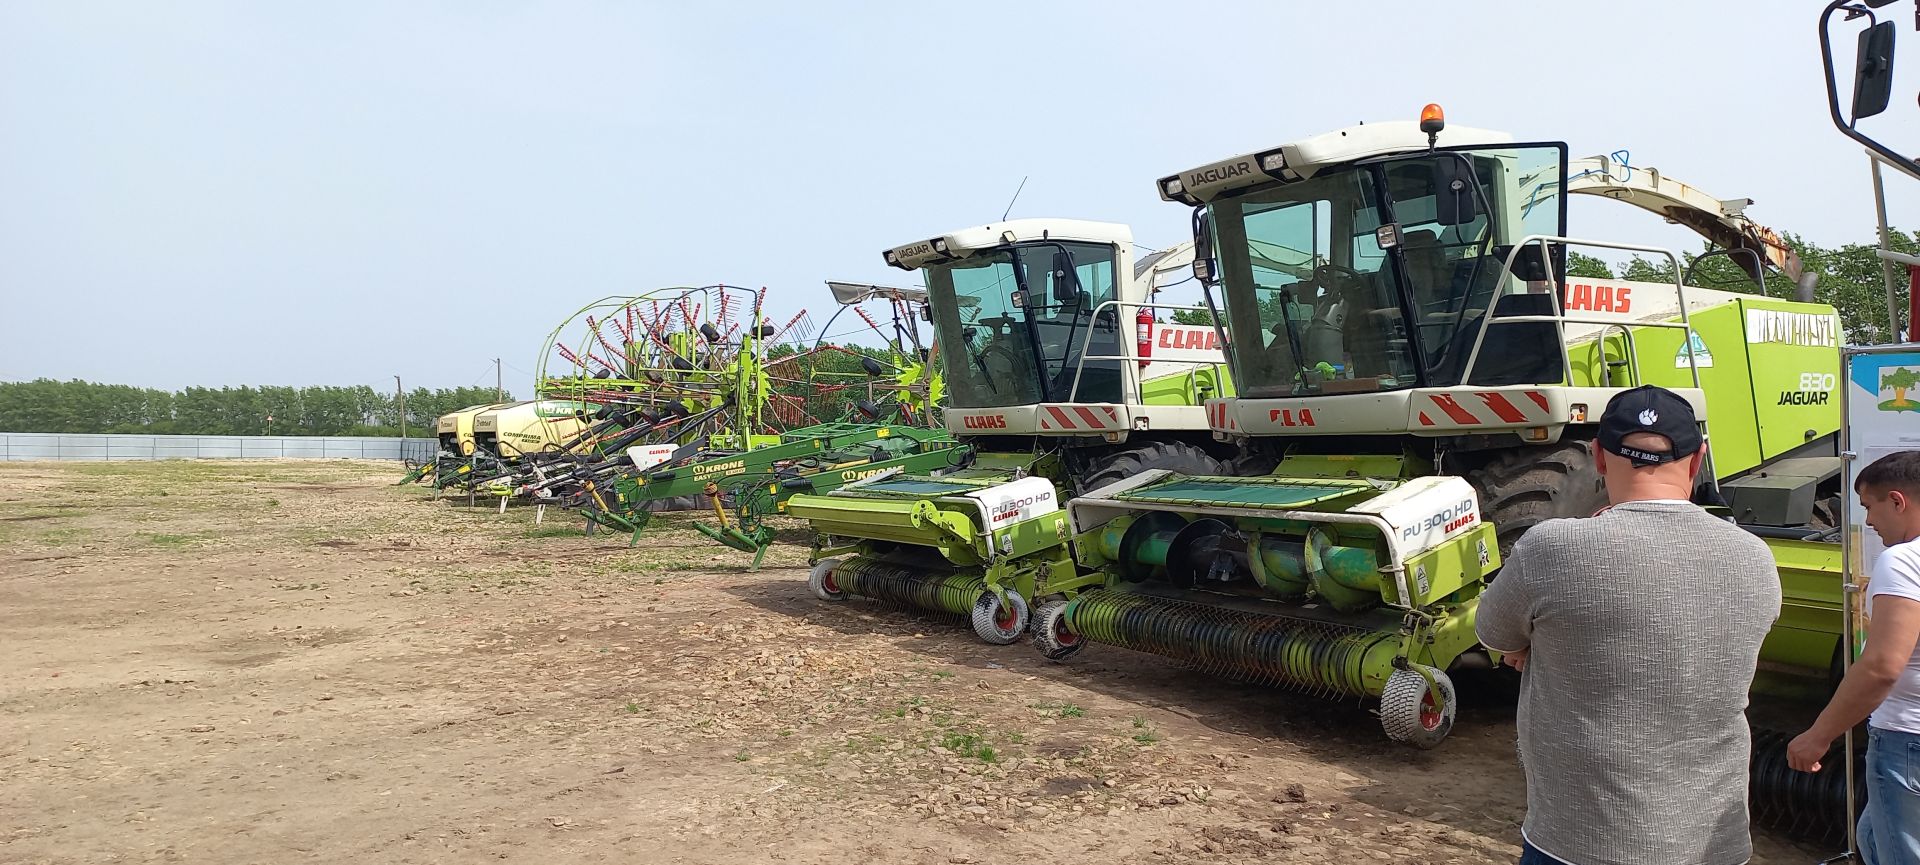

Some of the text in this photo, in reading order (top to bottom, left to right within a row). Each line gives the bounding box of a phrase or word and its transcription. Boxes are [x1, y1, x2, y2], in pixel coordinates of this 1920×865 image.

[1190, 161, 1251, 187] JAGUAR
[898, 244, 930, 258] JAGUAR
[1158, 328, 1230, 350] CLAA
[1799, 372, 1835, 392] 830
[1777, 391, 1828, 406] JAGUAR
[963, 414, 1007, 429] CLAAS
[503, 432, 541, 440] COMPRIMA
[1631, 450, 1641, 458] AK
[705, 460, 744, 474] KRONE
[992, 492, 1050, 515] PU 300 HD
[993, 509, 1019, 522] CLAAS
[1403, 498, 1473, 541] PU 300 HD
[1444, 513, 1475, 534] CLAAS
